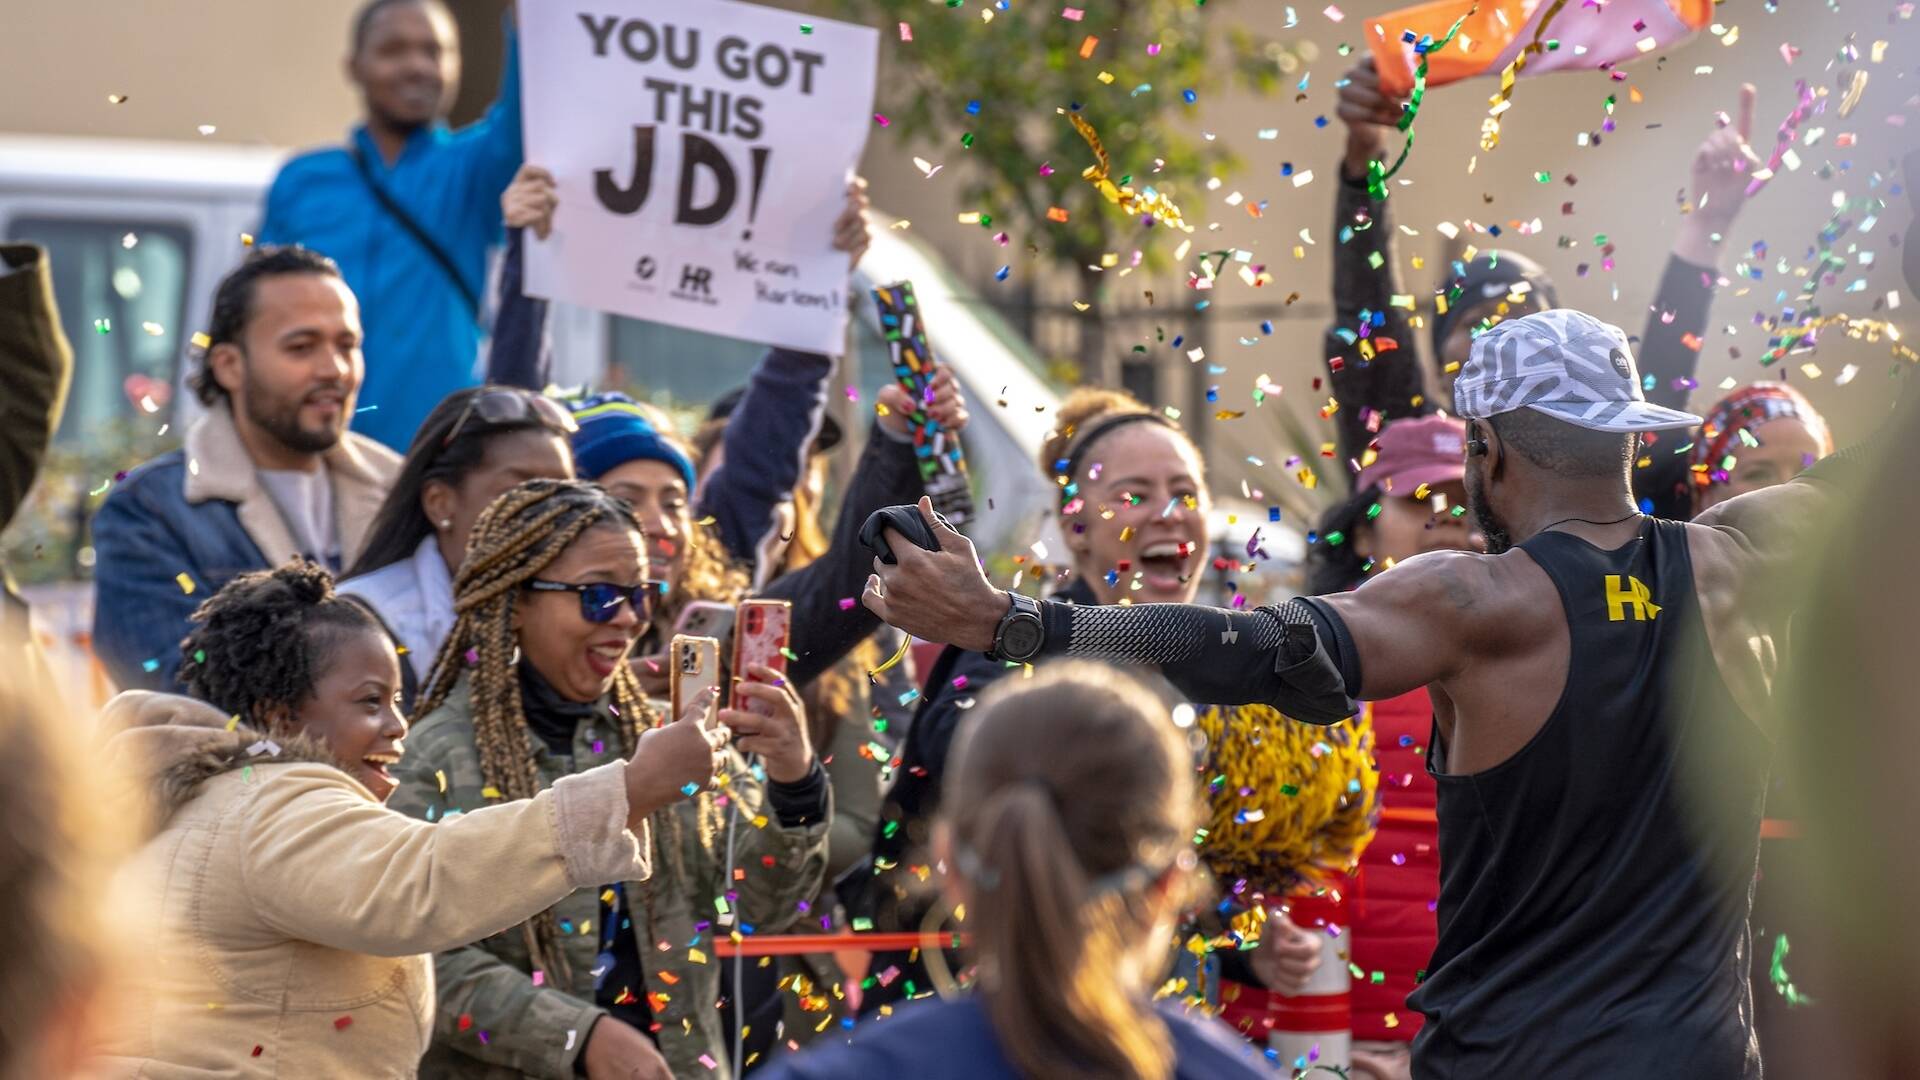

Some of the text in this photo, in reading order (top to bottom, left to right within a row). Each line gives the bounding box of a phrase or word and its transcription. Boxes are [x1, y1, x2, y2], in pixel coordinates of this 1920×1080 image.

[577, 13, 825, 95] YOU GOT
[643, 77, 764, 141] THIS
